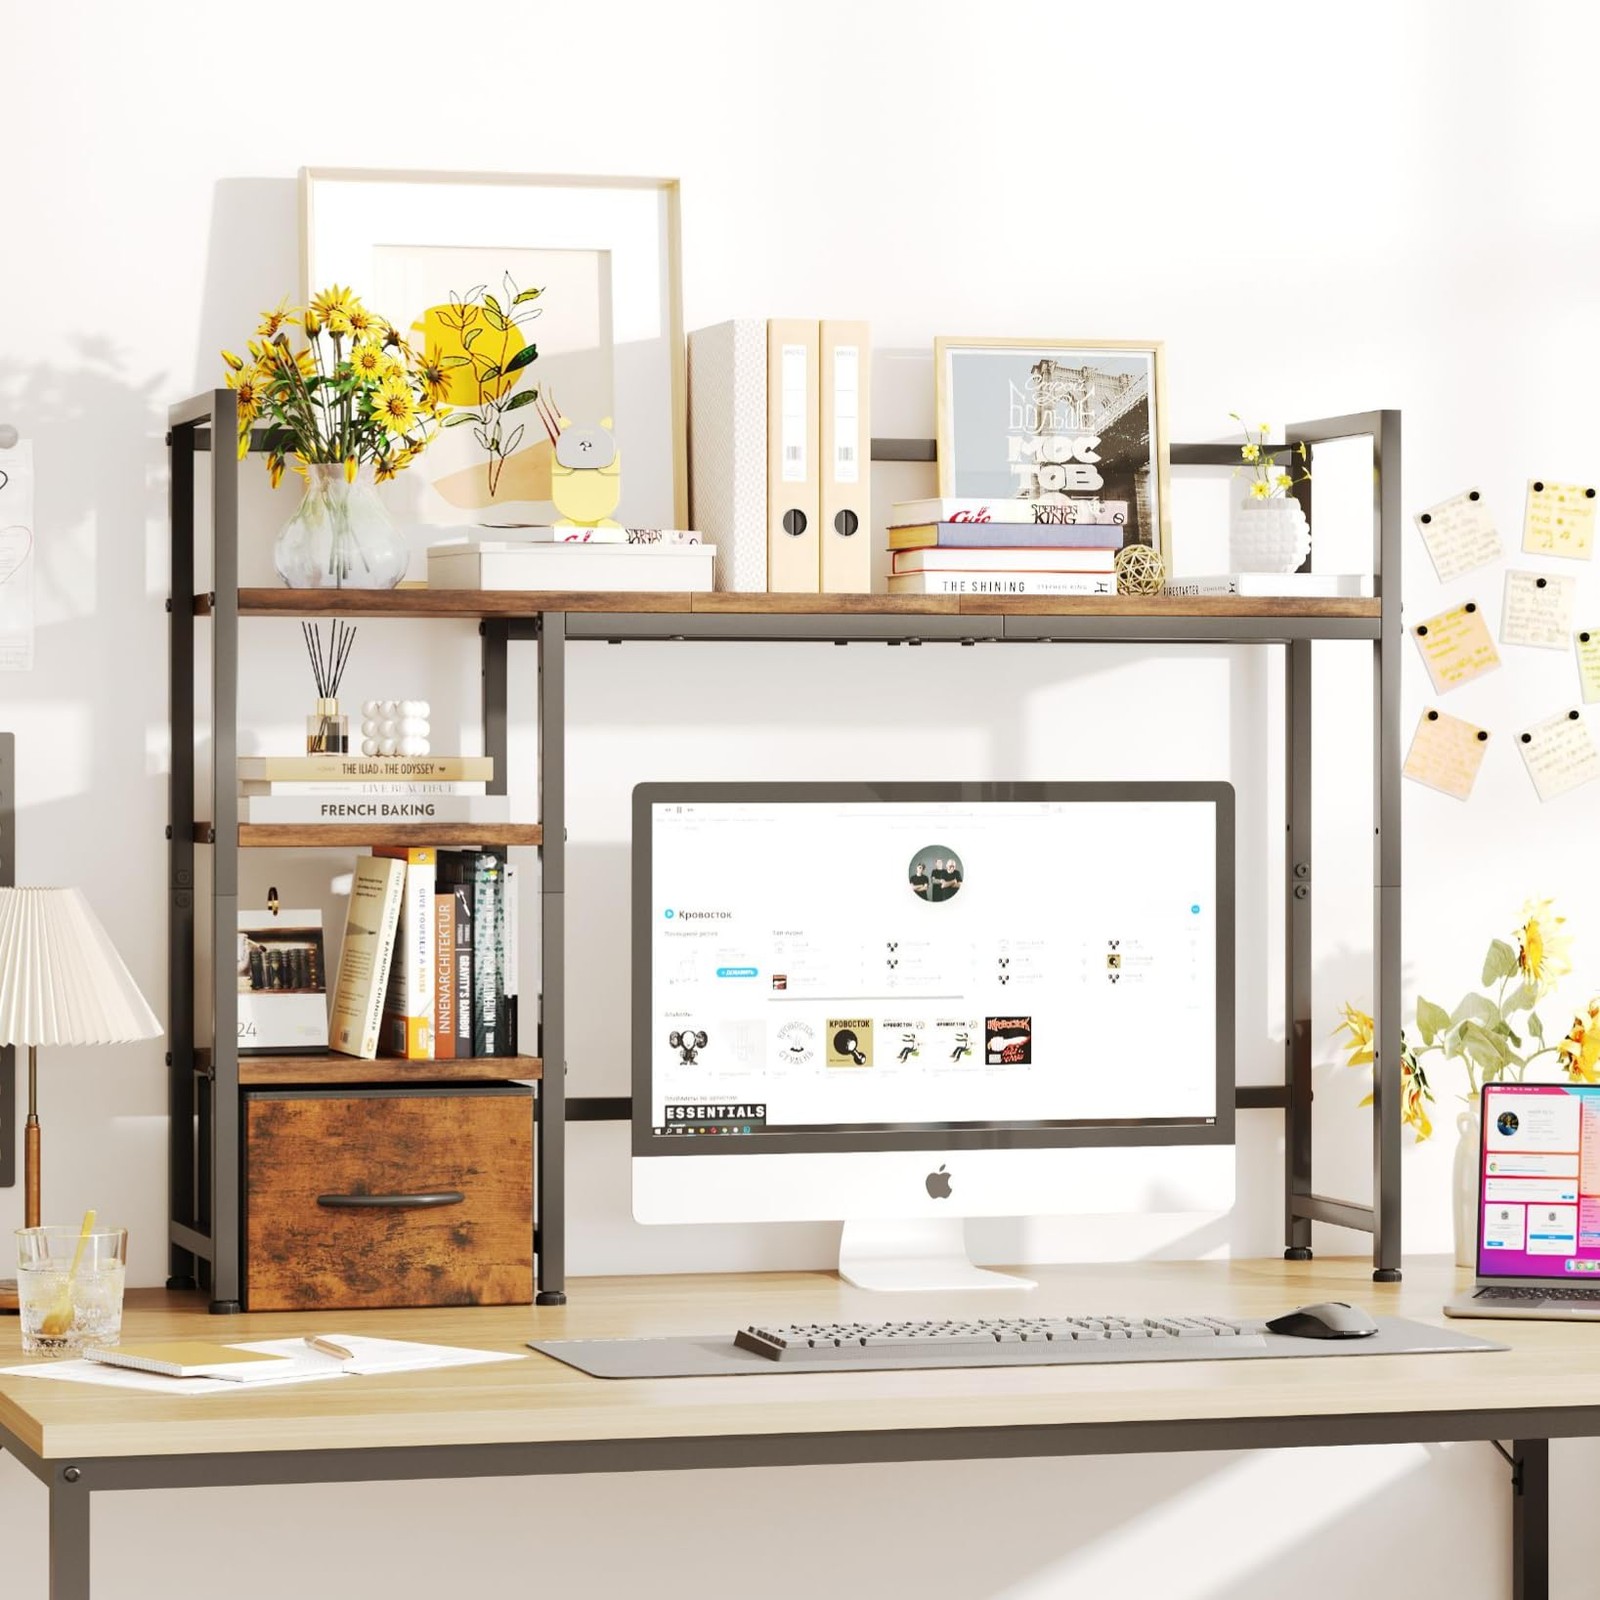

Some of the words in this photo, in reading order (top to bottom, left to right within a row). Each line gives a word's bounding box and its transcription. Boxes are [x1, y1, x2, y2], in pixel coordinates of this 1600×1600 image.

[1007, 435, 1102, 464] МОС
[1011, 463, 1104, 491] ТОВ
[1033, 511, 1077, 524] KING
[942, 581, 966, 592] THE
[971, 581, 1025, 592] SHINING
[342, 763, 357, 775] THE
[358, 763, 379, 775] ILIAD
[384, 763, 398, 775] THE
[400, 763, 435, 775] ODYSSEY
[321, 804, 377, 816] FRENCH
[381, 804, 435, 816] BAKING
[418, 888, 426, 908] GIVE
[678, 909, 733, 921] Кровосток
[418, 911, 426, 955] YOURSELF
[379, 941, 390, 985] RAYMOND
[438, 904, 451, 1034] INNENARCHITEKTUR
[459, 955, 470, 998] GRAVITY'S
[459, 999, 470, 1039] RAINBOW
[829, 1019, 870, 1029] КРОВОСТОК
[666, 1105, 765, 1119] ESSENTIALS
